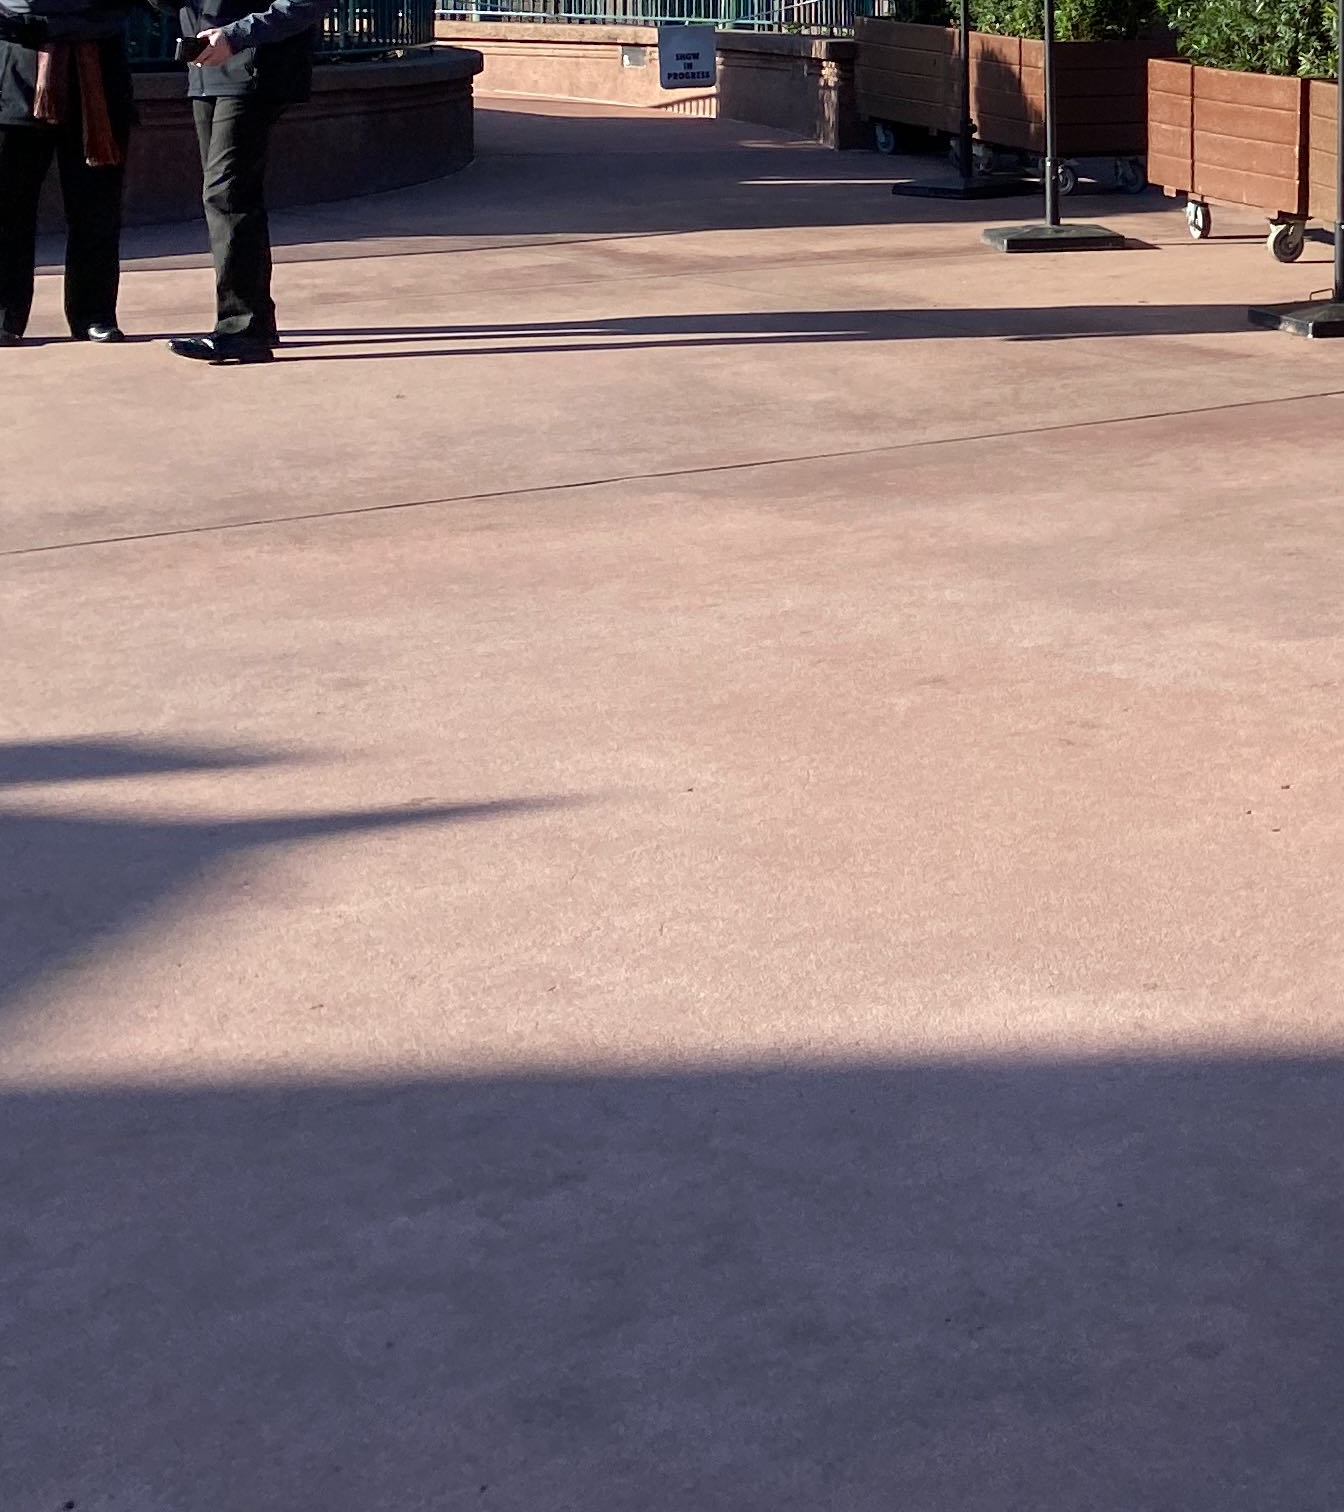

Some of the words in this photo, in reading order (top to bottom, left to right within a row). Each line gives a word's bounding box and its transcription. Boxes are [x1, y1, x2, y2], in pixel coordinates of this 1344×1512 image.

[675, 52, 700, 61] SHOW
[683, 62, 693, 70] IN
[667, 70, 711, 80] PROGRESS
